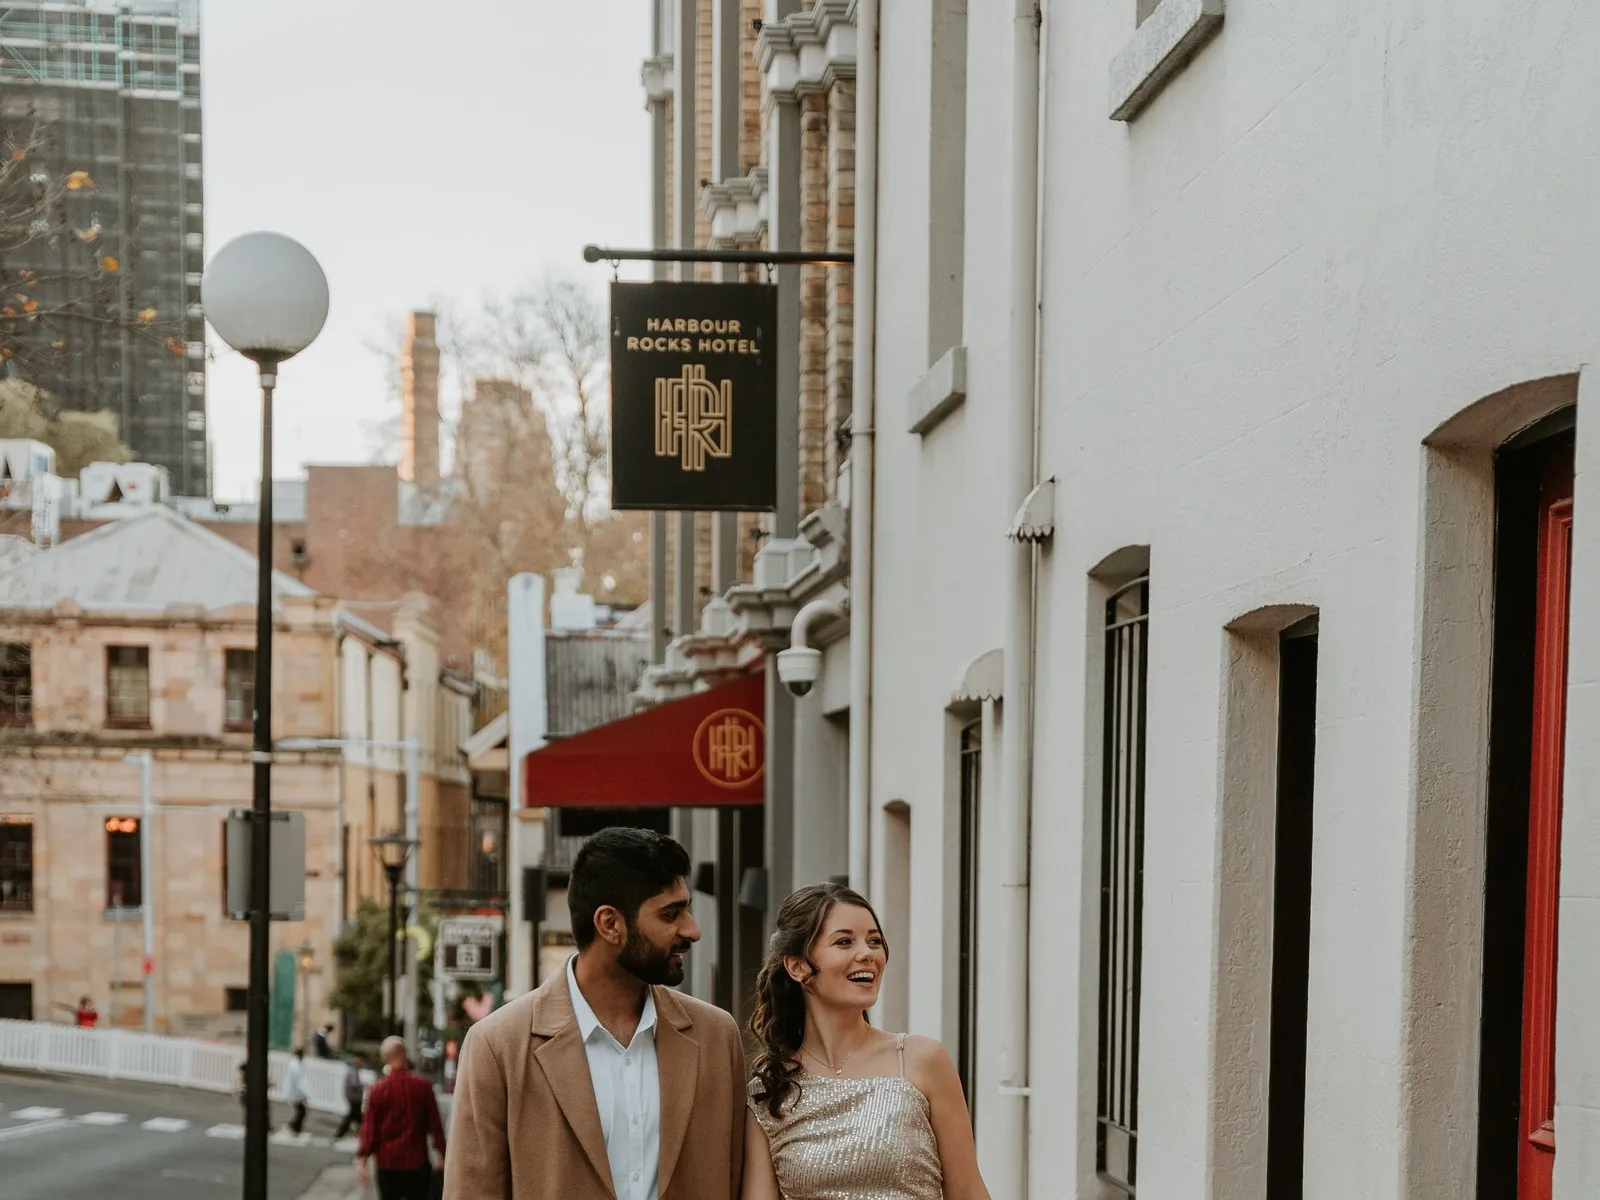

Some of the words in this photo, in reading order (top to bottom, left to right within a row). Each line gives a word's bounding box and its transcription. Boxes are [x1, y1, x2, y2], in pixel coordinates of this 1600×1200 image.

[647, 318, 741, 334] HARBOUR
[627, 336, 692, 352] ROCKS
[698, 338, 761, 355] HOTEL
